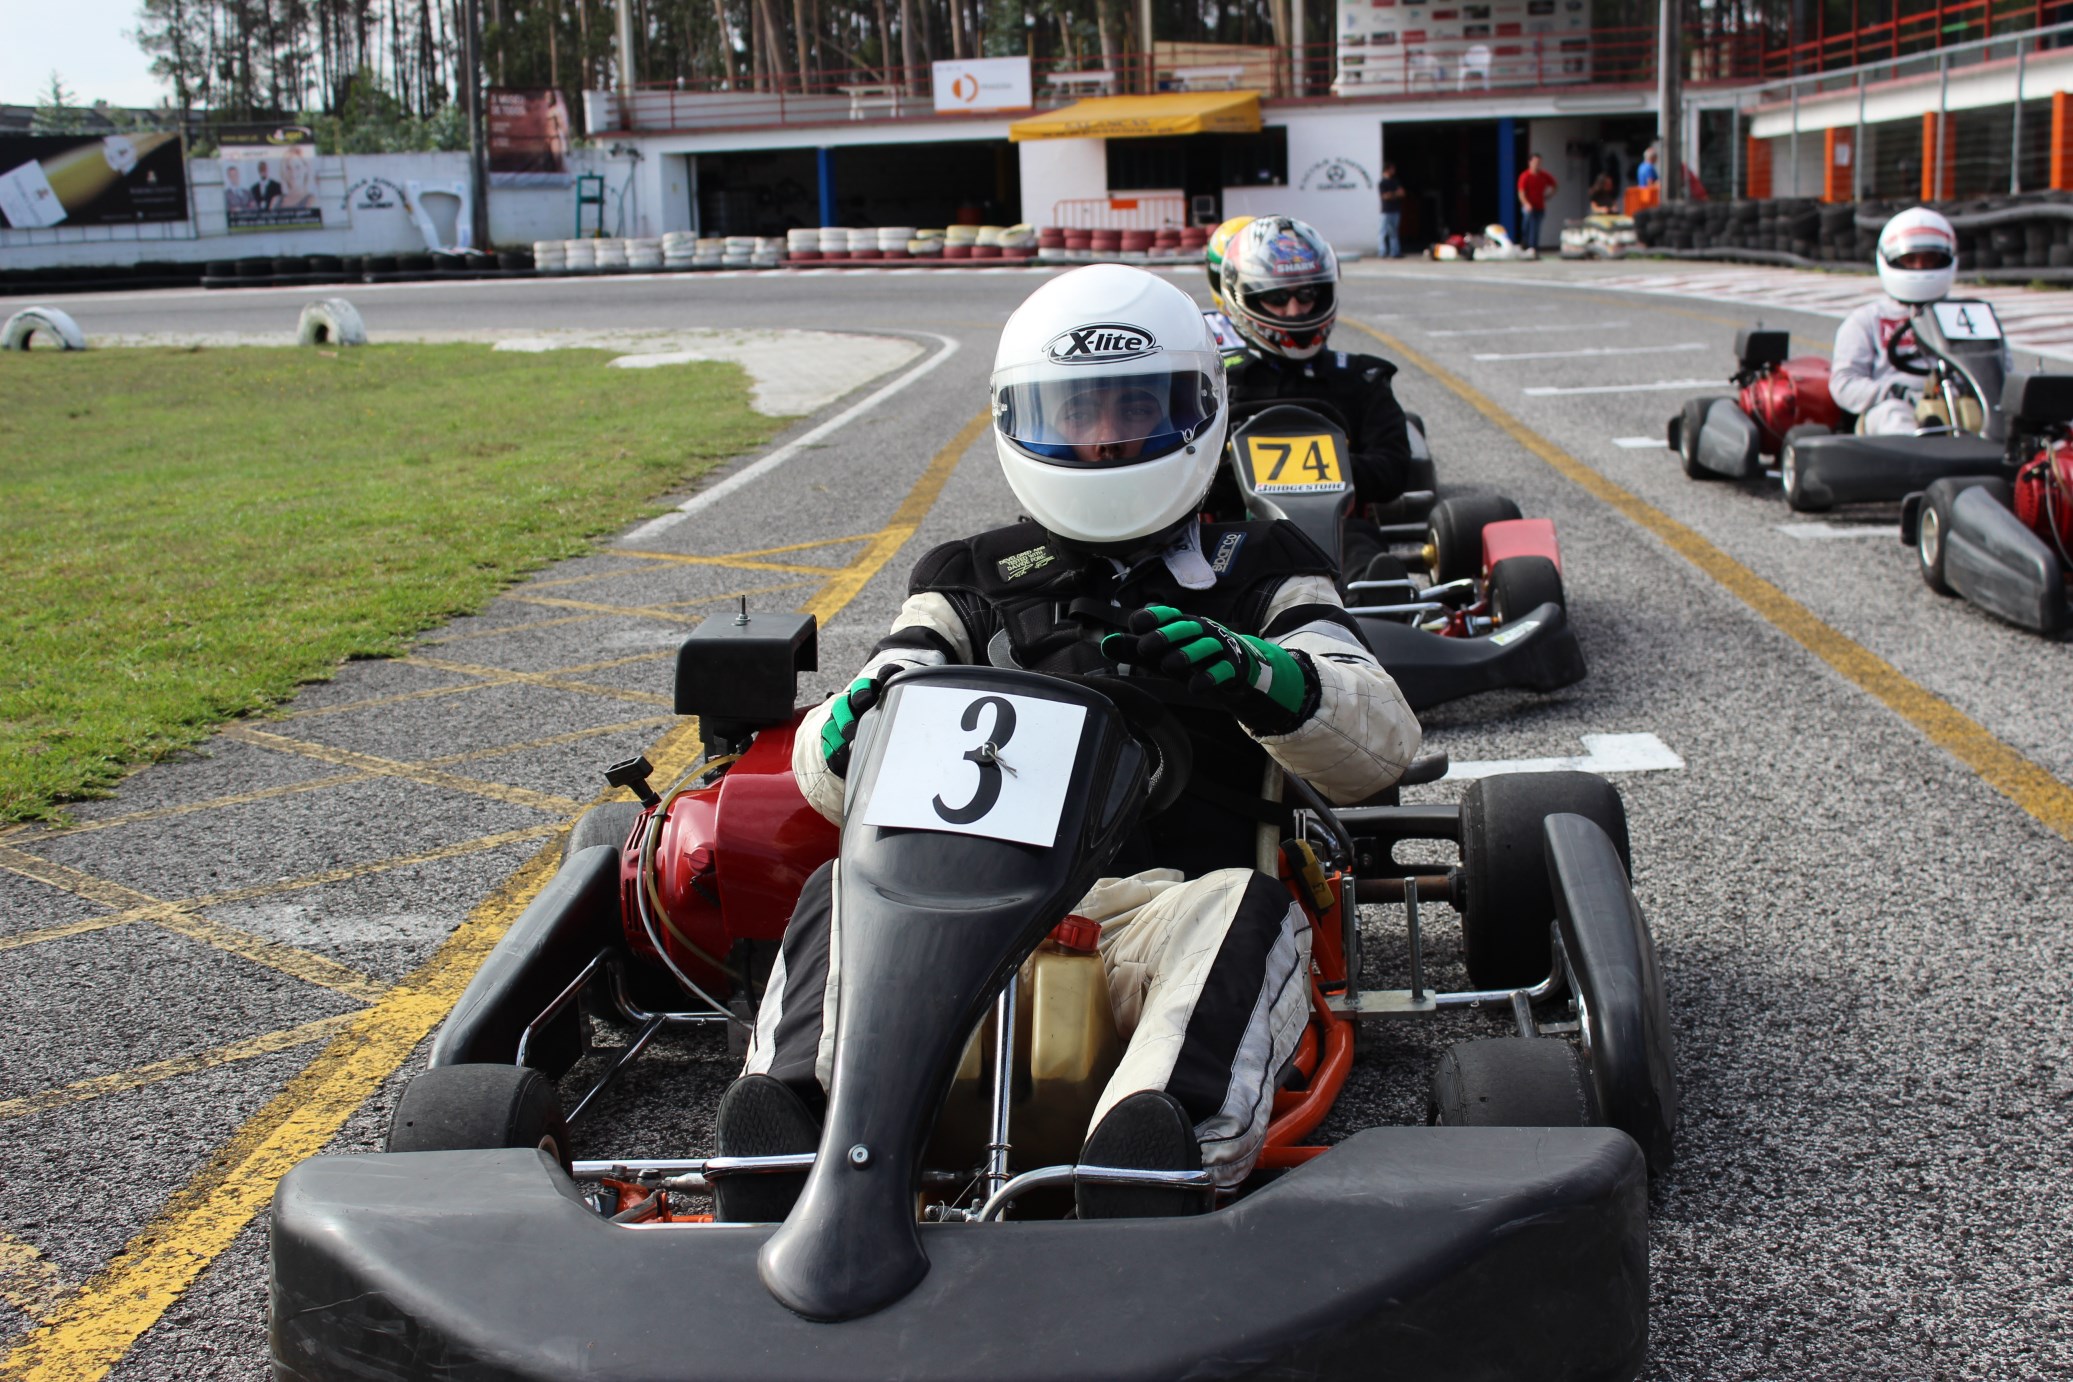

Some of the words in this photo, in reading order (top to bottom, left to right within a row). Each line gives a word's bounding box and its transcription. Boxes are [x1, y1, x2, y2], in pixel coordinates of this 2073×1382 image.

[1277, 261, 1316, 273] SHARK
[1957, 306, 1975, 335] 4
[1064, 330, 1143, 356] X-lite
[1257, 440, 1332, 482] 74
[1257, 483, 1342, 493] BRIDGESTONE
[1211, 533, 1238, 572] sparco
[932, 695, 1017, 825] 3
